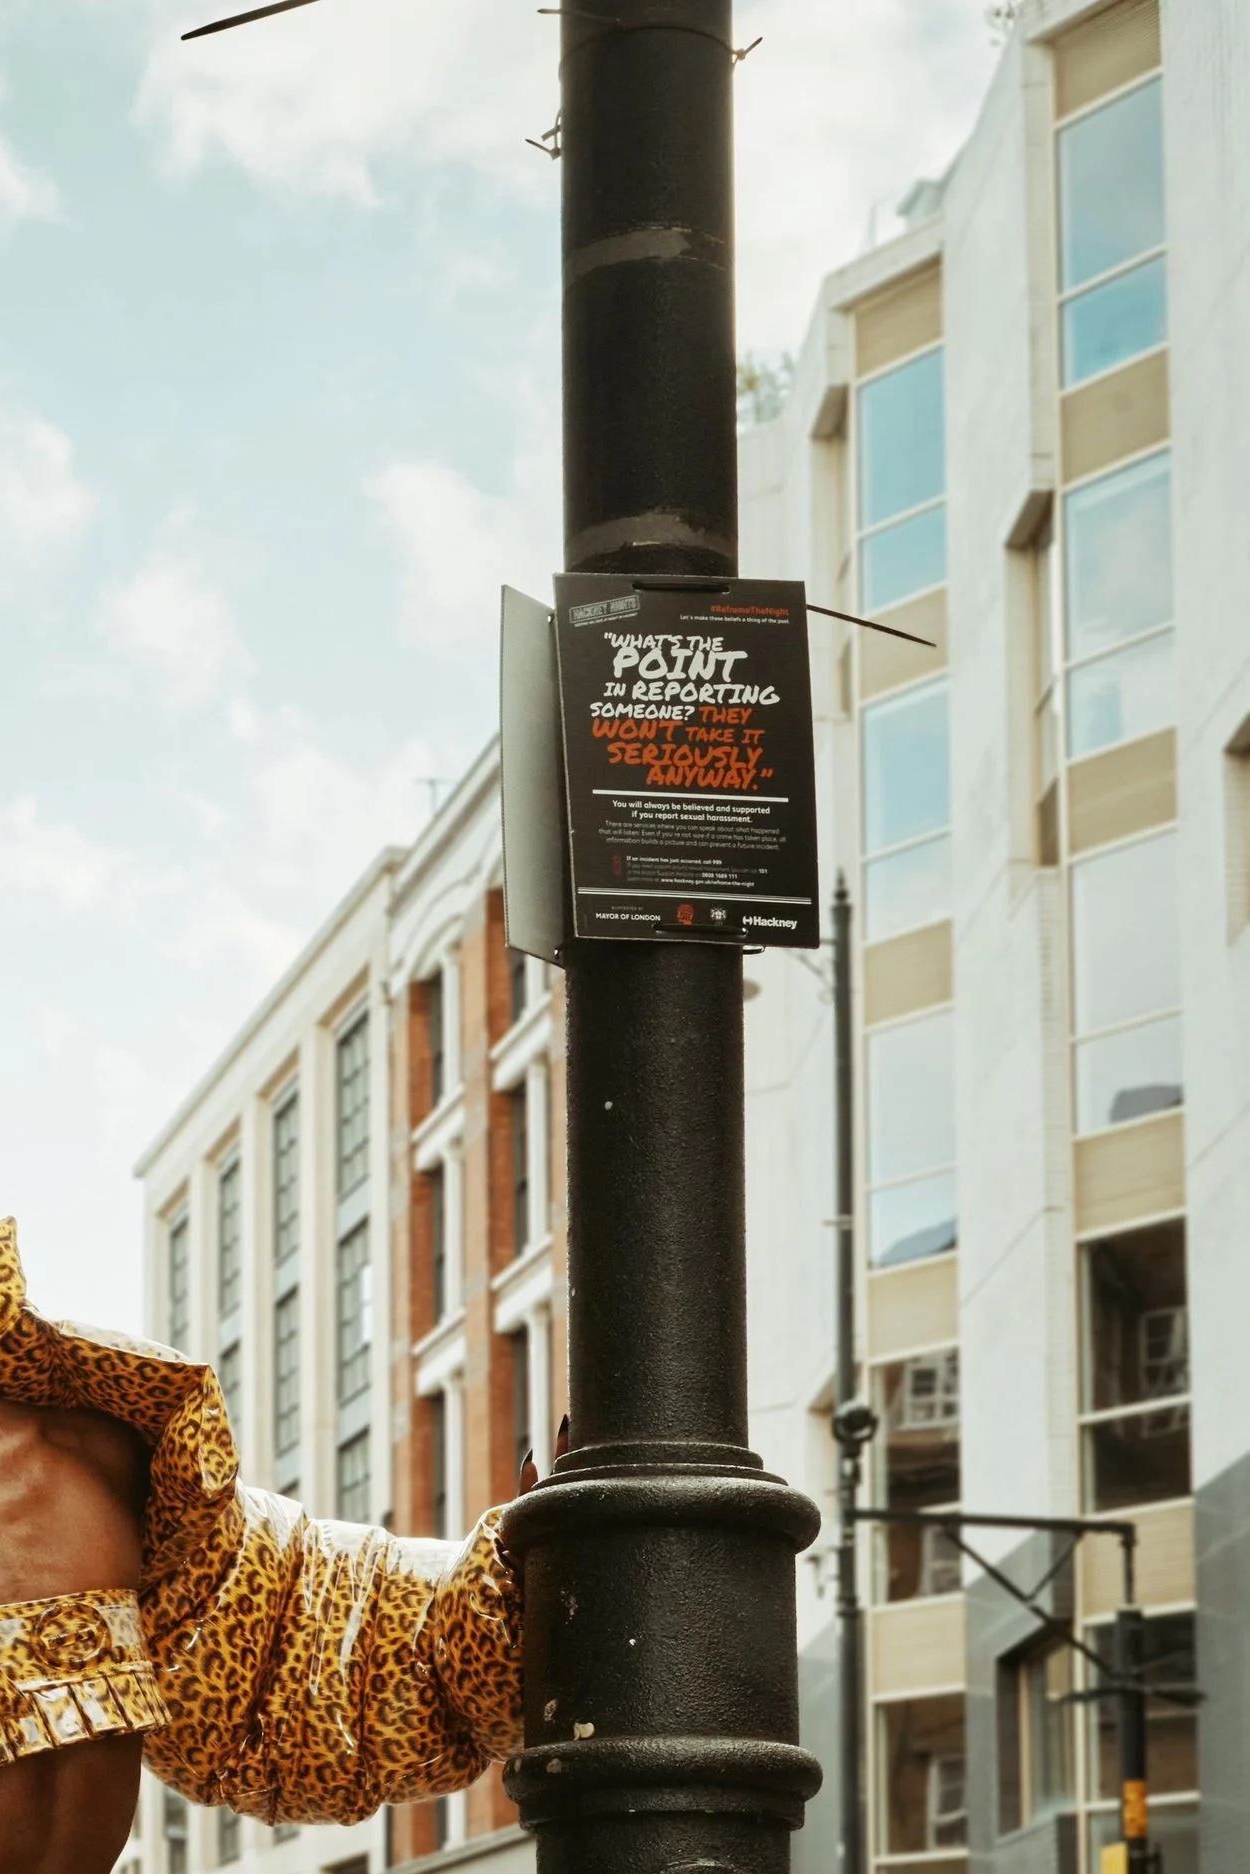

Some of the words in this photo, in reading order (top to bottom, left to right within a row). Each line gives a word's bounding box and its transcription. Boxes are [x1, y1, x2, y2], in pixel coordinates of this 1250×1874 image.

[686, 636, 724, 652] THE
[612, 647, 748, 682] POINT
[604, 682, 626, 697] IN
[632, 680, 780, 705] REPORTING
[590, 702, 695, 721] SOMEONE?
[698, 706, 753, 724] THEY
[685, 726, 735, 743] TAKE
[742, 730, 766, 744] IT
[606, 742, 764, 770] SERIOUSLY
[646, 766, 774, 791] ANYWAY."
[612, 800, 627, 808] You
[644, 802, 670, 811] always
[682, 803, 714, 812] believed
[732, 806, 770, 814] supported
[706, 814, 753, 823] harassment.
[754, 916, 797, 930] Hackney
